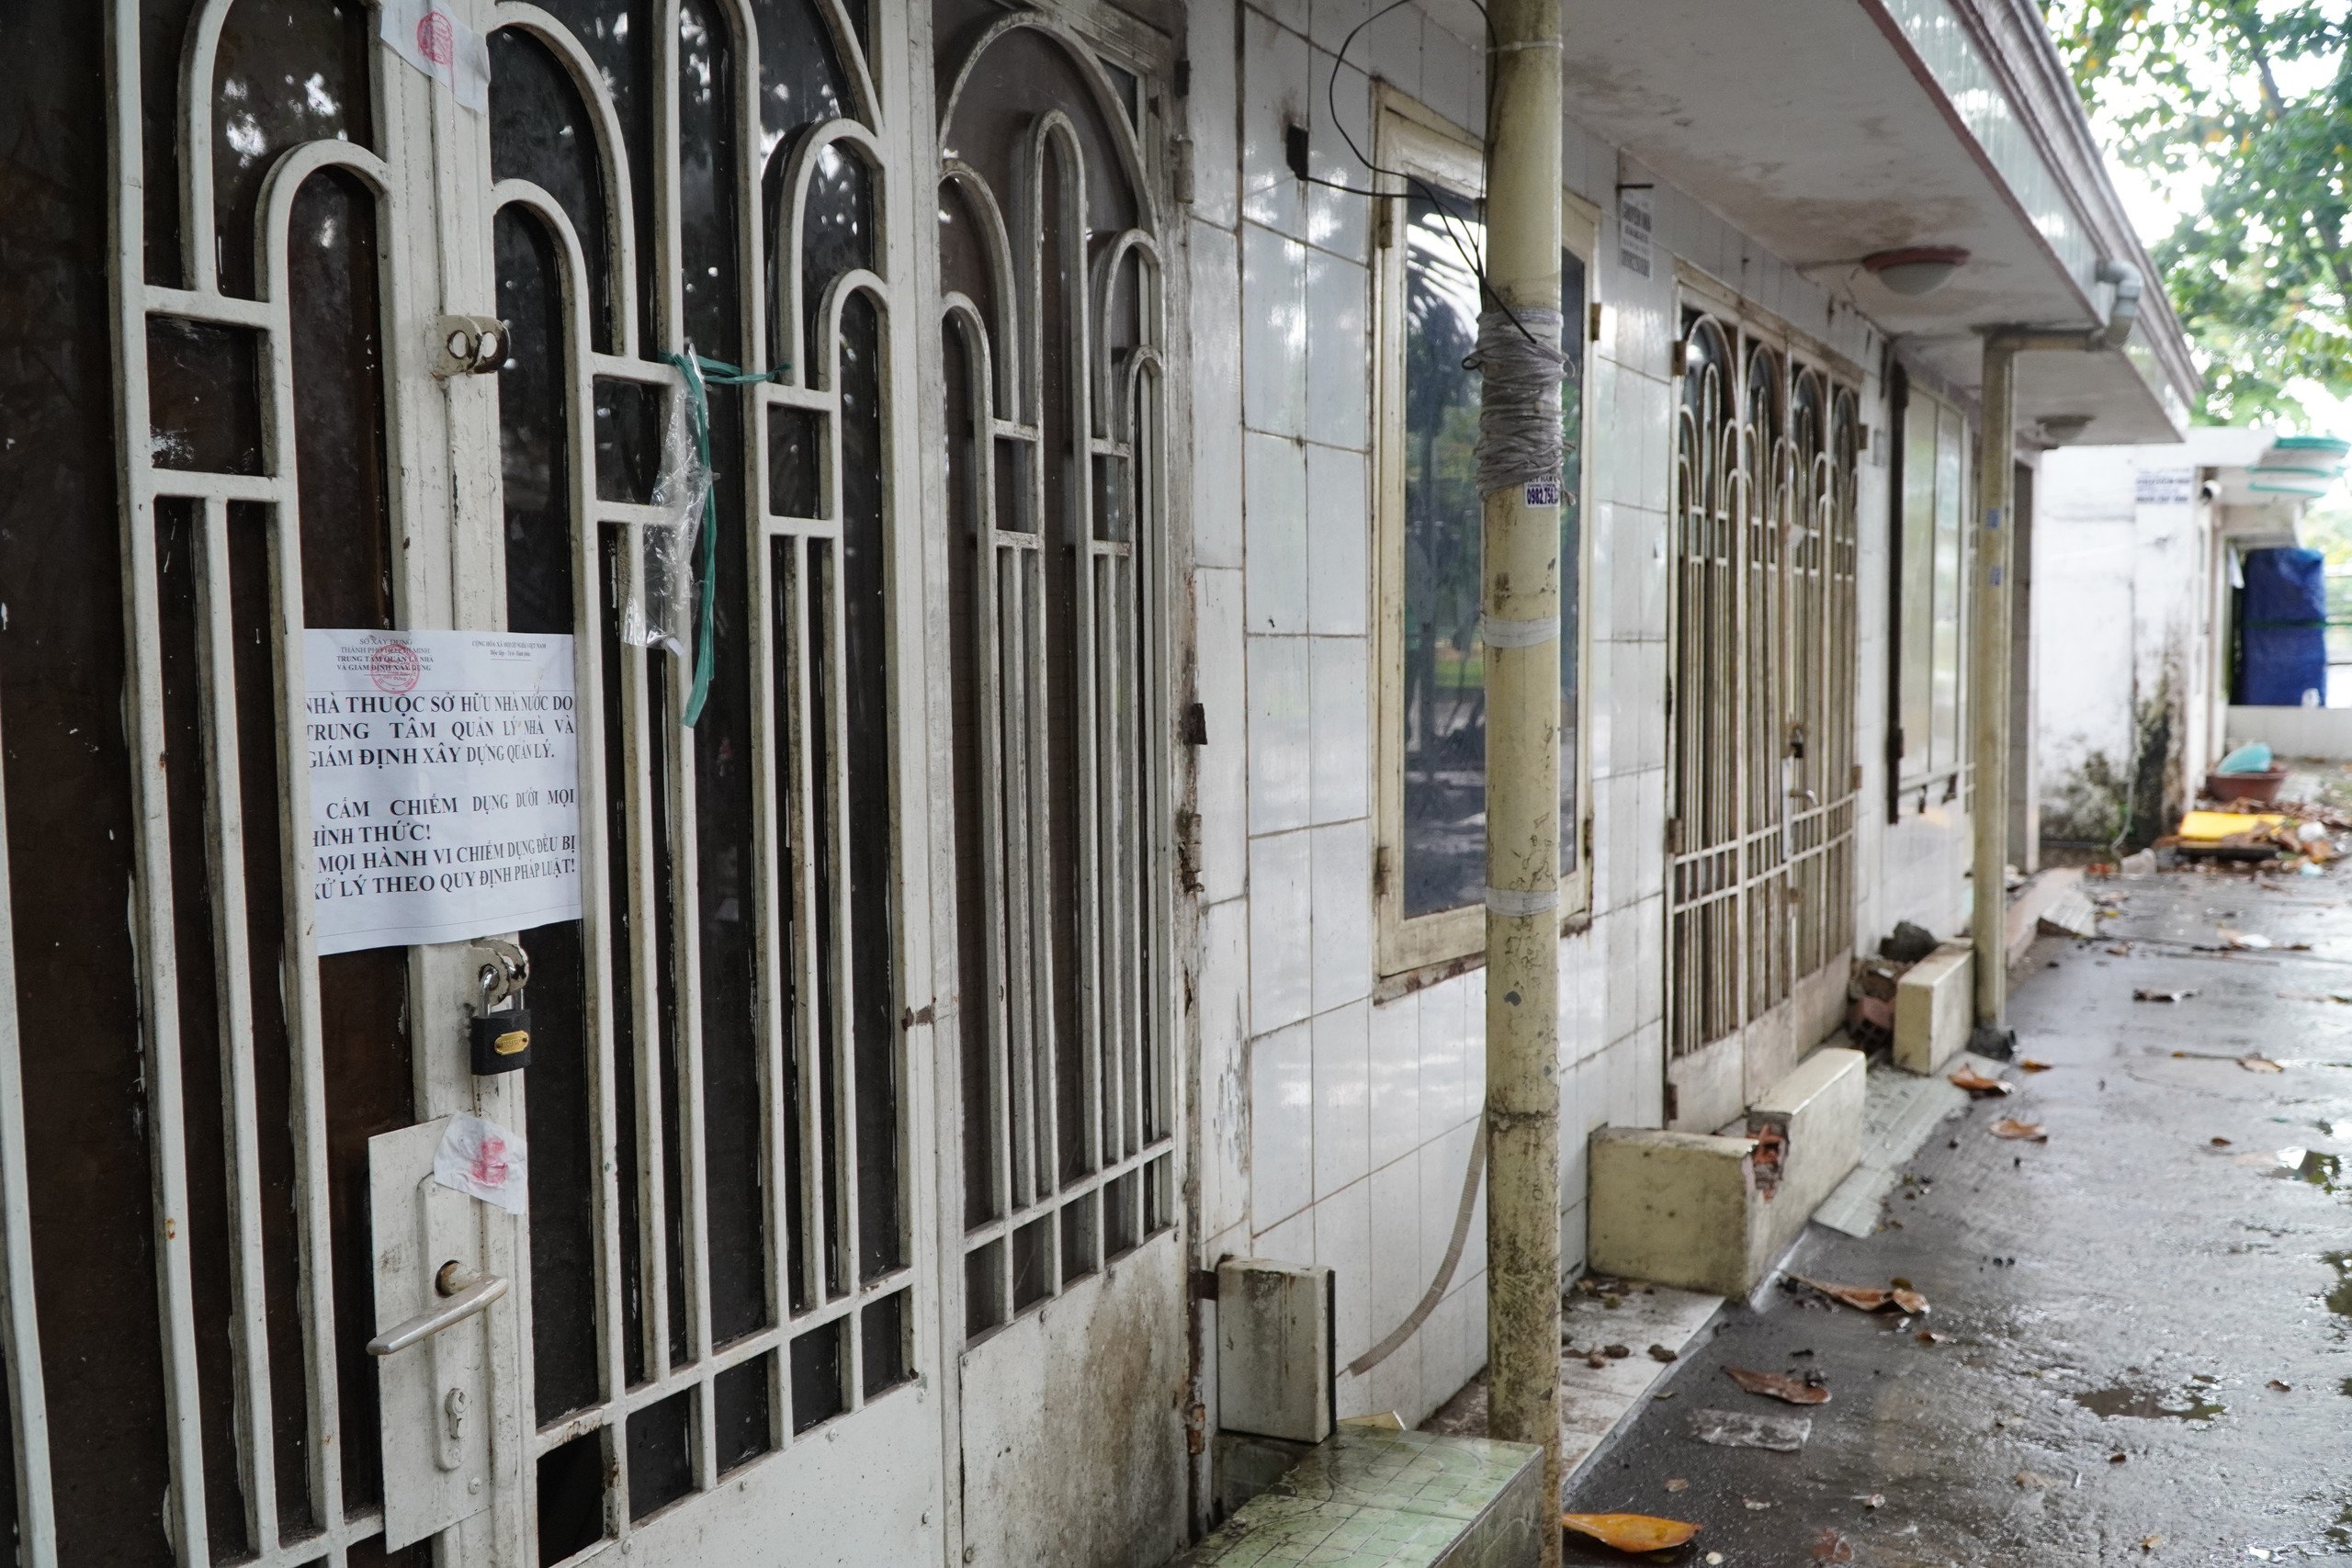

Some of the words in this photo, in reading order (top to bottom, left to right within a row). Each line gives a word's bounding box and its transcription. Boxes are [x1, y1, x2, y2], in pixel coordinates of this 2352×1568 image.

[340, 646, 367, 654] THÀNH
[345, 694, 425, 716] THUỘC
[430, 692, 456, 713] SỞ
[460, 693, 491, 713] HỮU
[494, 691, 519, 712] NHÀ
[521, 691, 548, 712] NƯỚC
[552, 695, 573, 711] DO
[307, 722, 369, 741] TRUNG
[389, 716, 436, 739] TÂM
[451, 716, 493, 741] QUẢN
[503, 715, 517, 736] LÝ
[524, 715, 545, 736] NHÀ
[554, 714, 574, 734] VÀ
[358, 749, 417, 770] ĐỊNH
[423, 741, 461, 764] XÂY
[466, 743, 504, 765] DỰNG
[506, 739, 533, 764] QUẢN
[534, 739, 555, 759] LÝ.
[326, 796, 370, 819] CẤM
[390, 793, 458, 817] CHIẾM
[472, 794, 508, 815] DỤNG
[515, 786, 538, 808] DƯỚI
[548, 788, 574, 807] MỌI
[312, 824, 354, 847] HÌNH
[358, 820, 431, 843] THỨC!
[318, 855, 356, 875] MỌI
[361, 846, 427, 870] HÀNH
[433, 848, 452, 865] VI
[457, 840, 503, 863] CHIẾM
[507, 838, 536, 861] DỤNG
[537, 832, 558, 854] ĐỀU
[562, 835, 575, 853] BỊ
[340, 874, 367, 897] LÝ
[372, 874, 435, 894] THEO
[440, 872, 476, 893] QUY
[479, 866, 512, 889] ĐỊNH
[514, 859, 540, 880] PHÁP
[541, 857, 575, 878] LUẬT!
